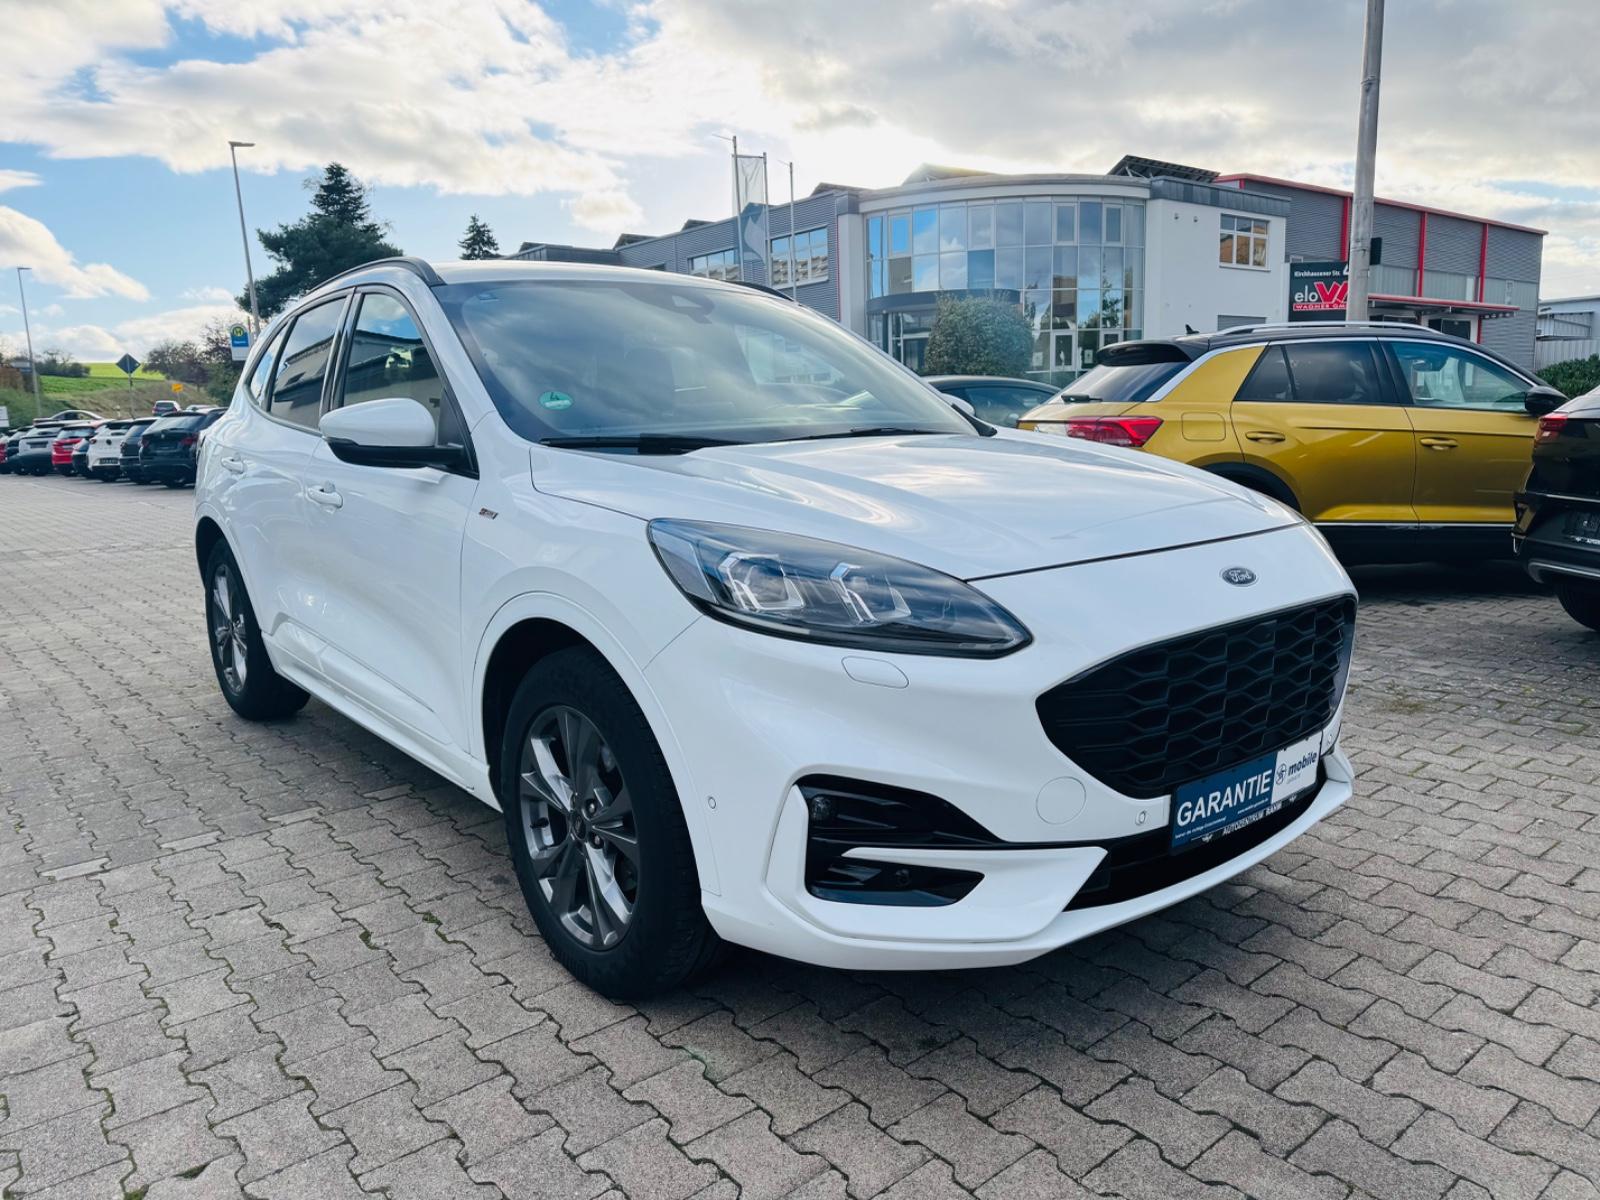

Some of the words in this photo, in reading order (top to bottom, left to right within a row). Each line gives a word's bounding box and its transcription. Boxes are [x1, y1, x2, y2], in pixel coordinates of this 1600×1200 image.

[1229, 569, 1252, 582] Ford
[1288, 752, 1317, 776] mobile
[1176, 769, 1273, 827] GARANTIE
[1222, 811, 1264, 835] AUTOZENTRUM
